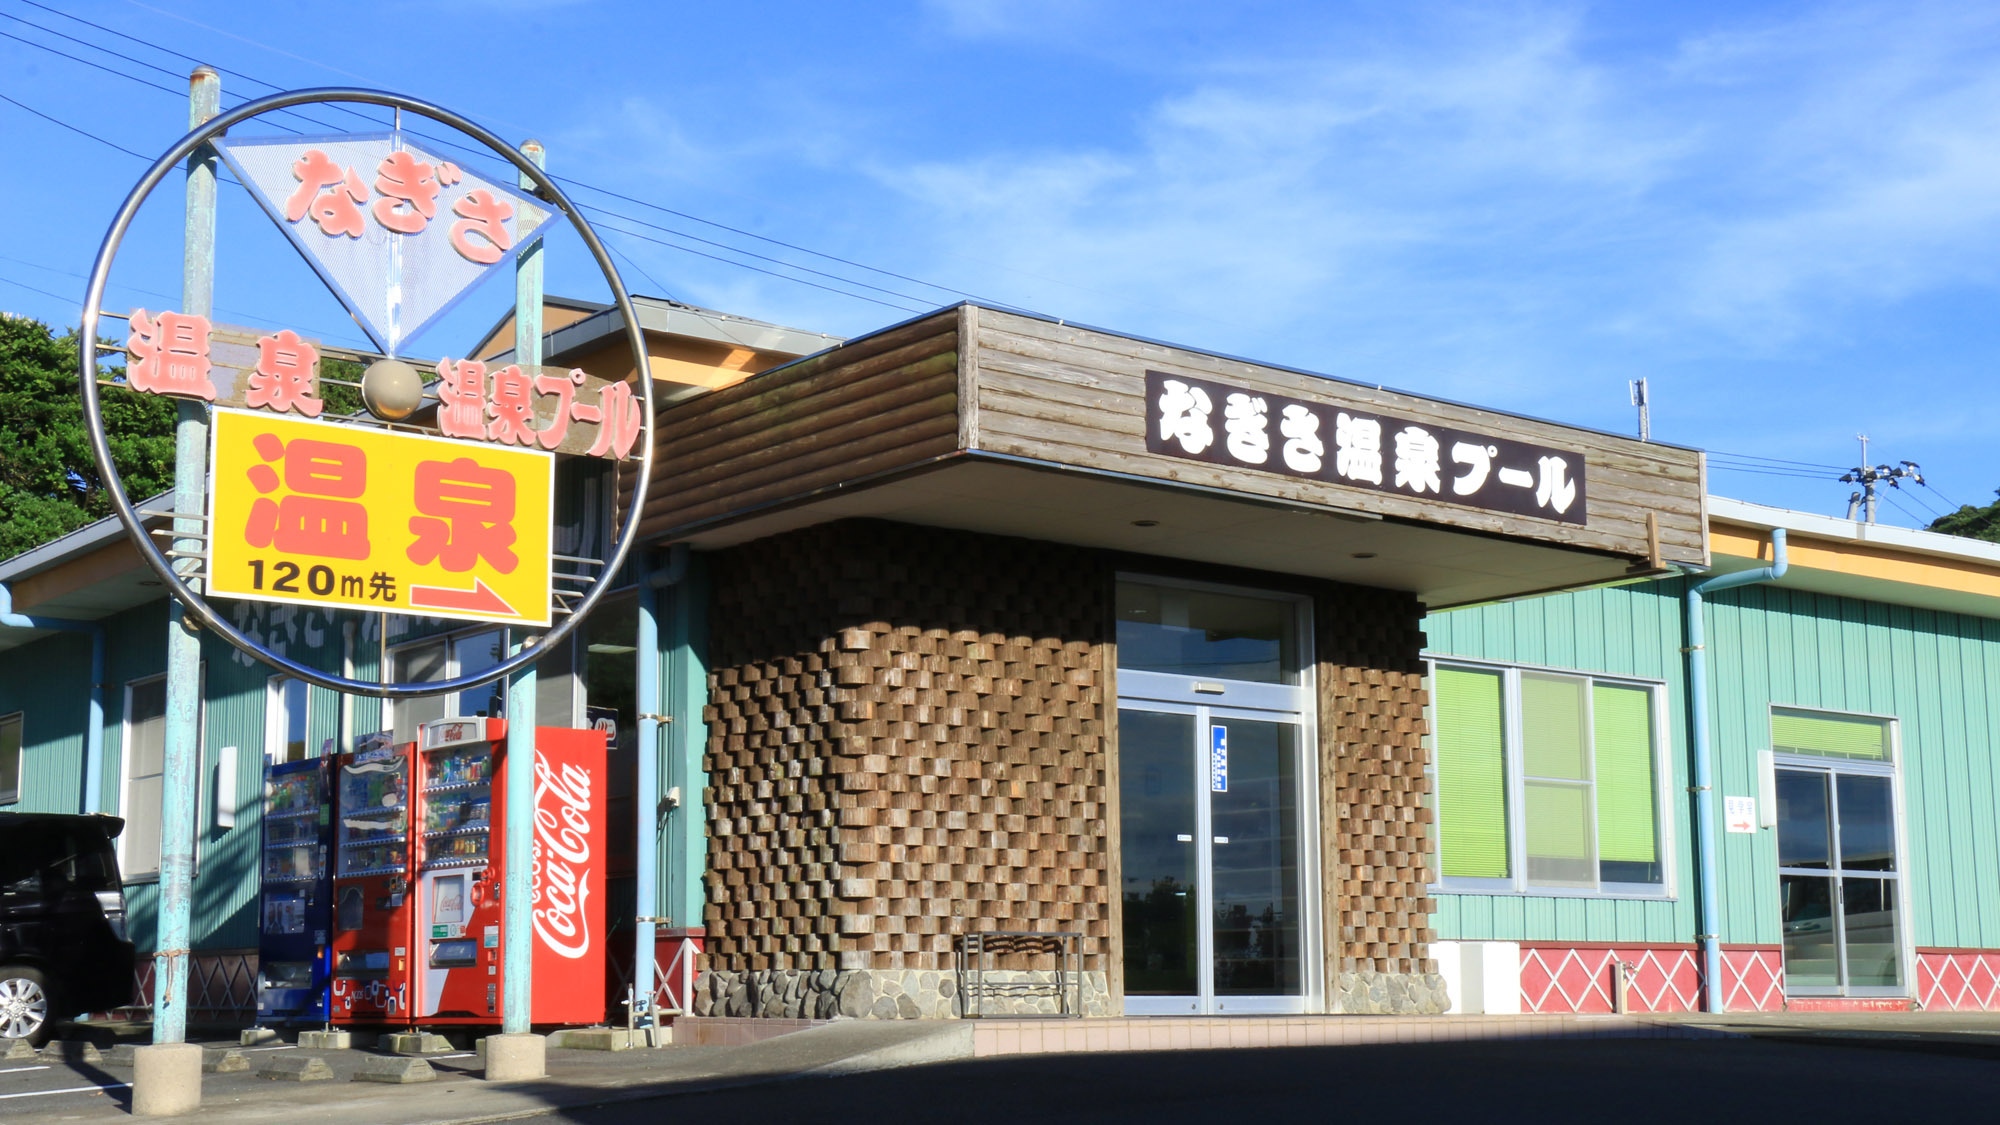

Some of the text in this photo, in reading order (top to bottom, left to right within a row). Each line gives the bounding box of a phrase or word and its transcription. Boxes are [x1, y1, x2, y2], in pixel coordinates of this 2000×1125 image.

[286, 149, 514, 264] なぎさ
[127, 308, 324, 417] 温泉
[435, 356, 642, 460] 温泉プール
[244, 432, 520, 575] 温泉
[1158, 379, 1577, 515] なぎさ温泉プール
[246, 559, 398, 603] 120m先
[532, 749, 591, 959] Coca-Cola
